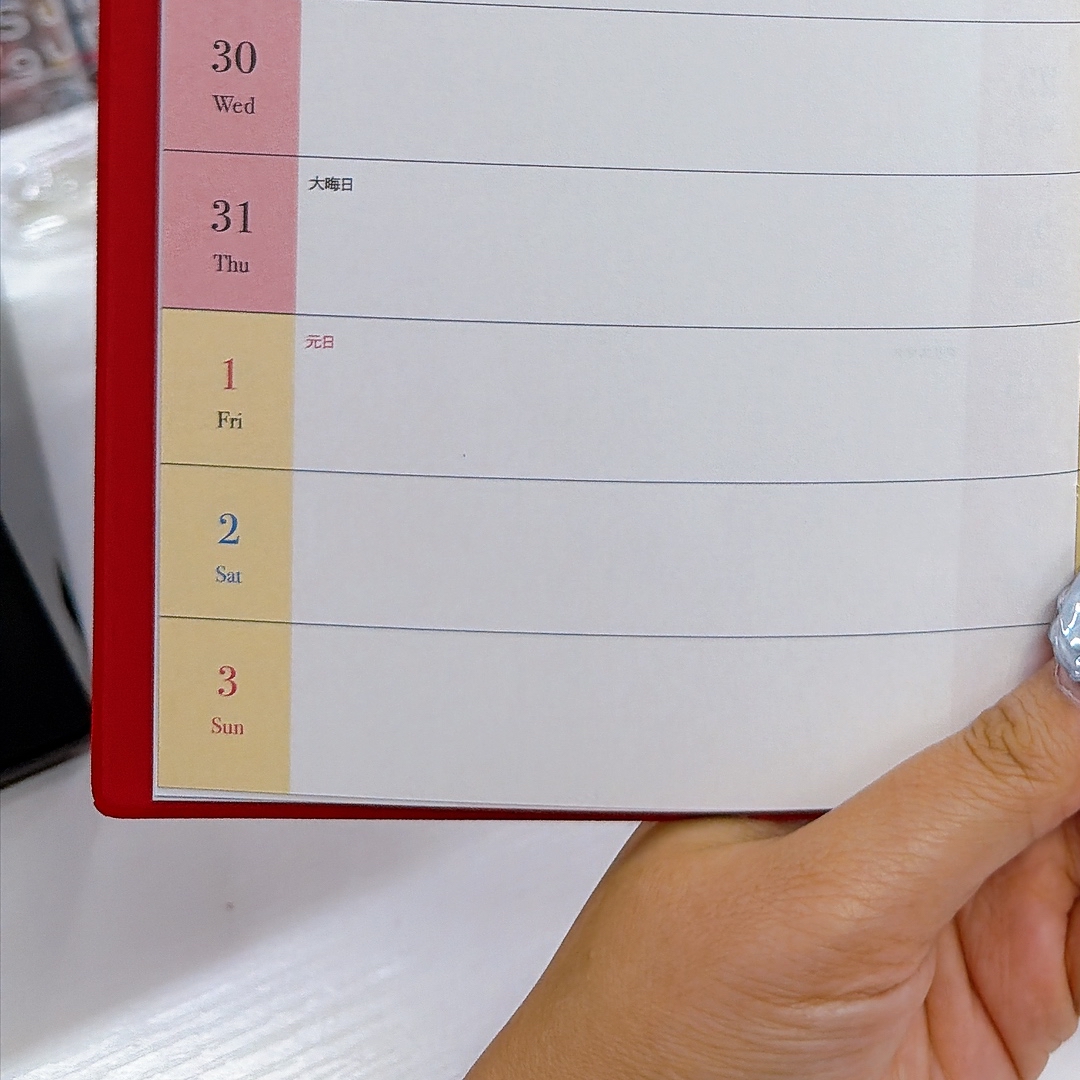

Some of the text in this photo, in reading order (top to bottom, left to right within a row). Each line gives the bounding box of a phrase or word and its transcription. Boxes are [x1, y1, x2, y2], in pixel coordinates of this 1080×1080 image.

[212, 40, 256, 73] 30
[212, 94, 255, 114] Wed
[309, 176, 352, 191] 大晦日
[211, 200, 252, 233] 31
[213, 253, 249, 273] Thu
[305, 334, 333, 349] 元日
[223, 358, 237, 390] 1
[218, 411, 241, 429] Fri
[218, 512, 239, 544] 2
[215, 565, 242, 583] Sat
[218, 666, 237, 697] 3
[212, 717, 244, 735] Sun
